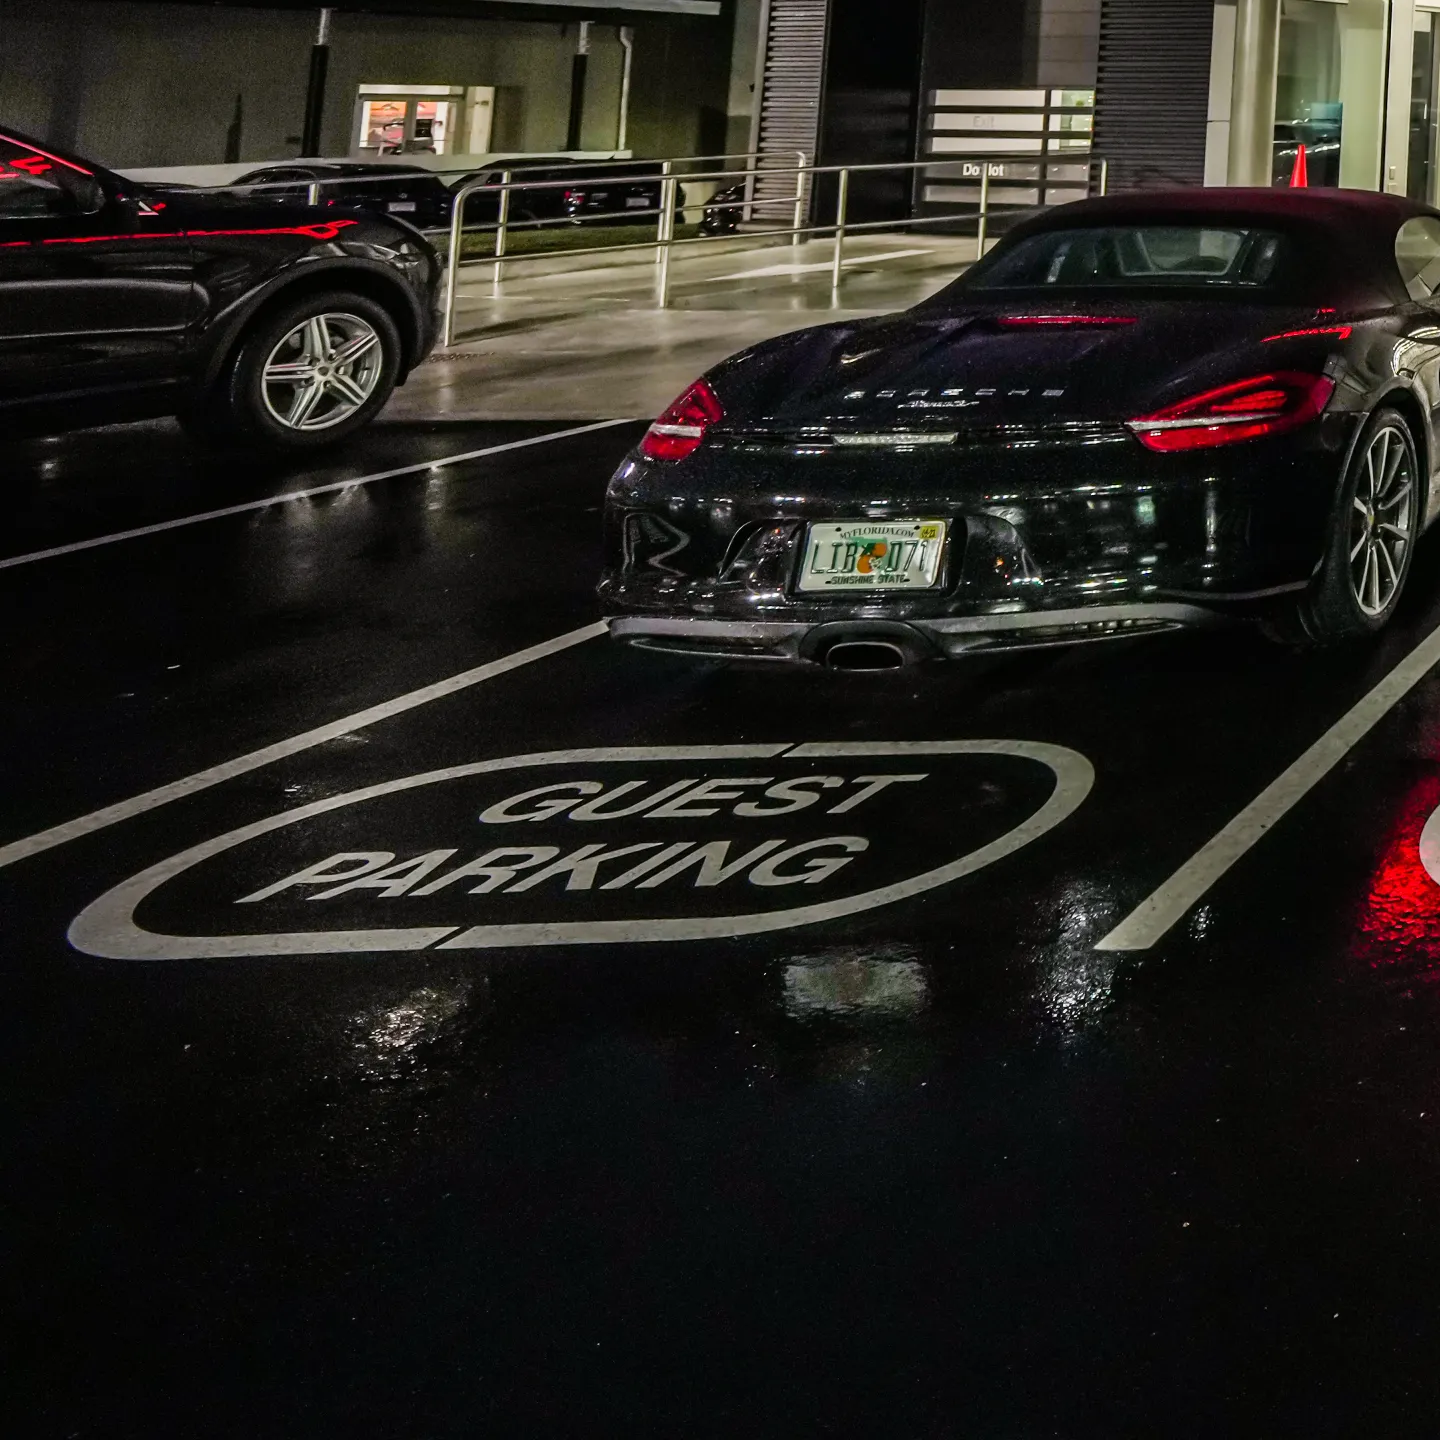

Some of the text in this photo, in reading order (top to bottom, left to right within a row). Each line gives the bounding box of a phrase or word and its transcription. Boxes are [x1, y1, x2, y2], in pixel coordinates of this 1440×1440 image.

[963, 163, 979, 176] Do
[840, 527, 914, 539] MYFLORIDA.COM
[831, 575, 905, 585] SUNSHINE STATE
[479, 774, 929, 824] GUEST
[233, 836, 871, 904] PARKING
